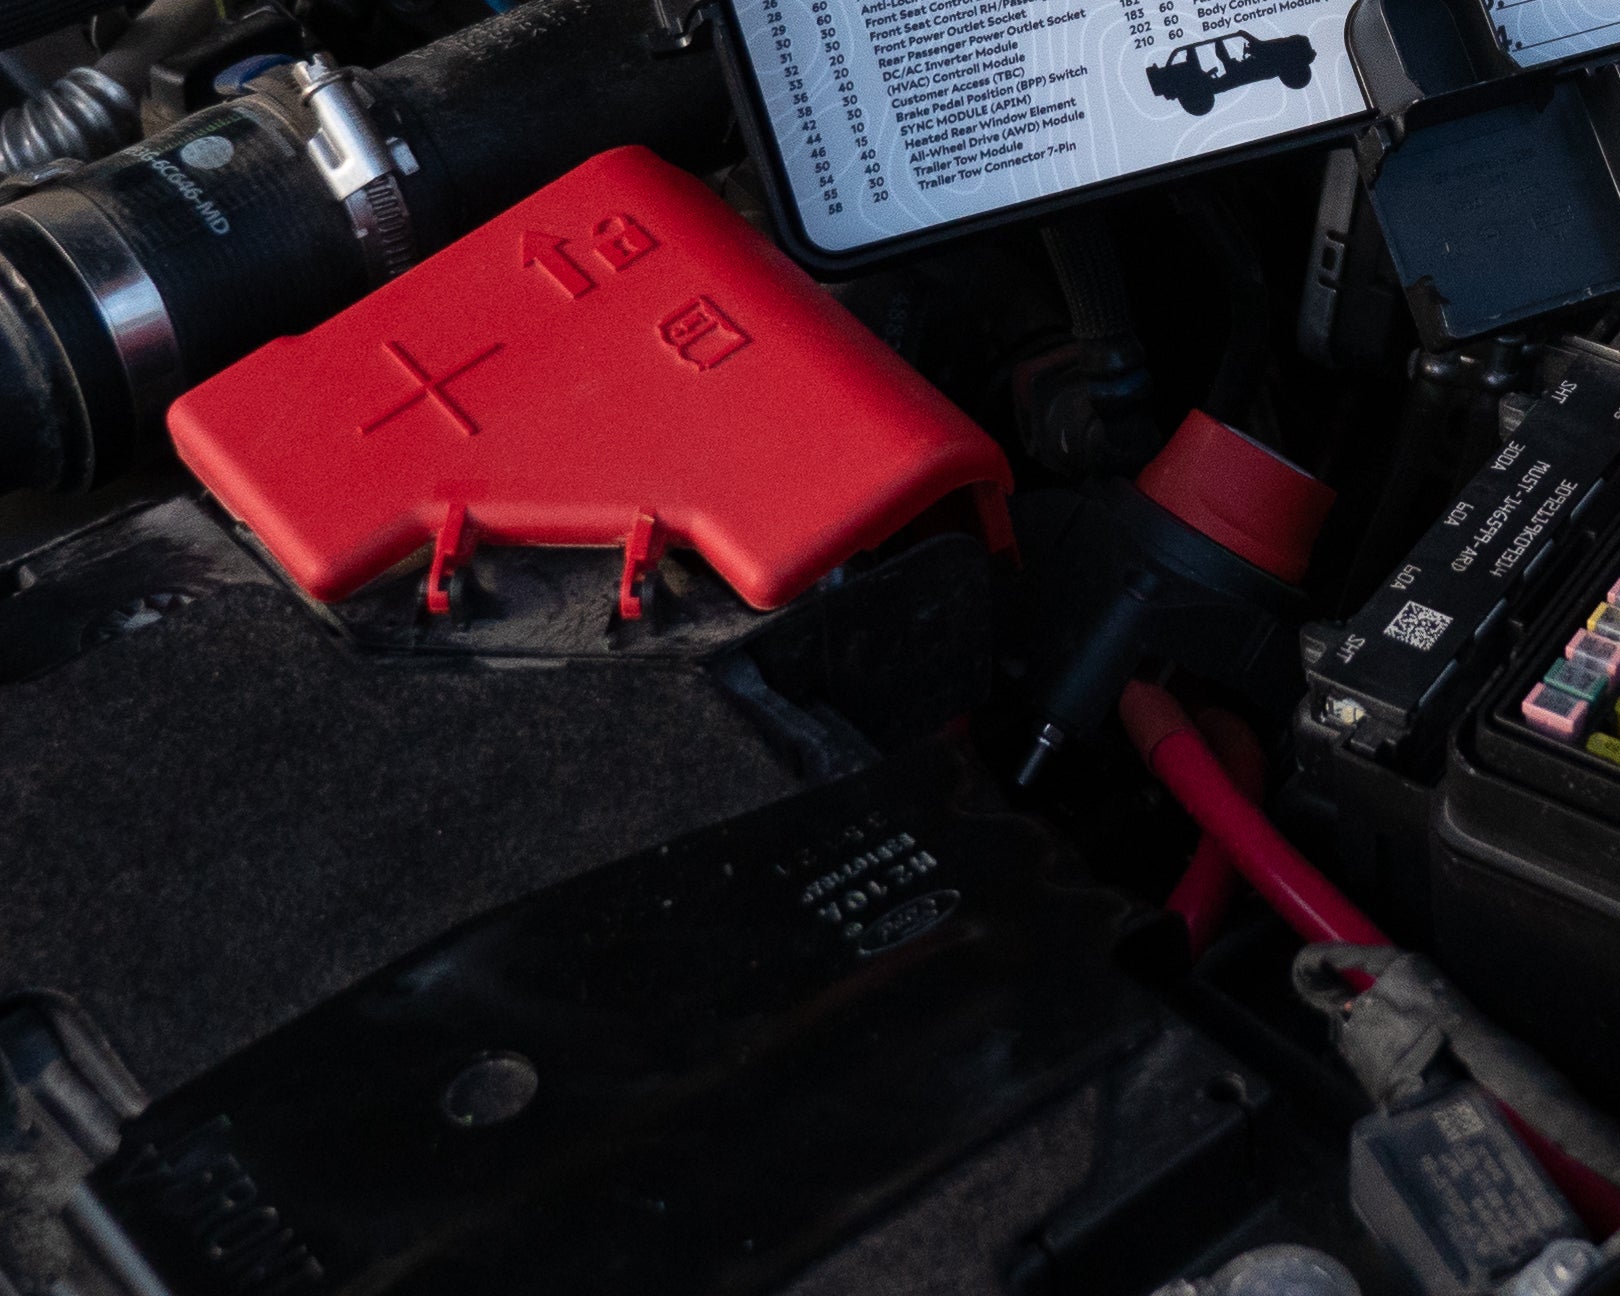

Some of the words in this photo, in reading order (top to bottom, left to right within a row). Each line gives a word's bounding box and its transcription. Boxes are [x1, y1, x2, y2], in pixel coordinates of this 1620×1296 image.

[779, 52, 793, 64] 31
[824, 40, 841, 53] 30
[869, 25, 902, 42] Front
[903, 18, 932, 34] Seat
[932, 5, 978, 26] Control
[801, 119, 817, 131] 42
[846, 107, 862, 121] 30
[890, 87, 949, 109] Customer
[951, 77, 990, 94] Access
[992, 66, 1025, 85] (TBC)
[809, 146, 826, 159] 46
[854, 135, 868, 148] 15
[900, 118, 934, 137] SYNC
[935, 104, 988, 127] MODULE
[990, 93, 1032, 114] (APIM)
[828, 201, 843, 215] 58
[872, 189, 889, 203] 20
[917, 174, 957, 191] Trailer
[957, 167, 982, 180] Tow
[984, 150, 1046, 173] Connector
[1046, 141, 1077, 156] 7-Pin
[1551, 380, 1577, 404] SHT
[1491, 440, 1525, 471] 300A
[1444, 501, 1474, 527] 60A
[1390, 564, 1422, 590] 60A
[1337, 634, 1366, 663] SHT
